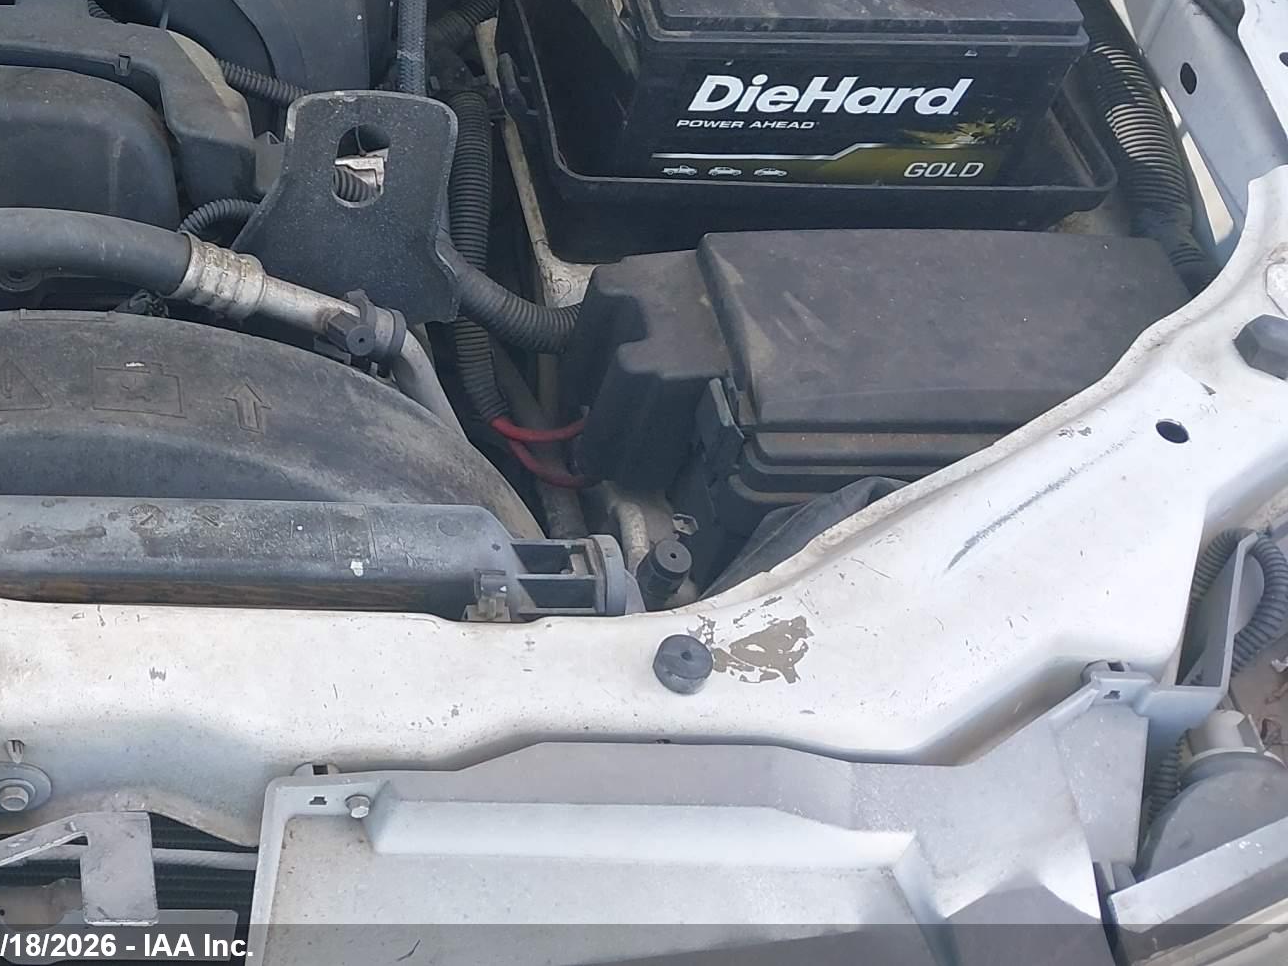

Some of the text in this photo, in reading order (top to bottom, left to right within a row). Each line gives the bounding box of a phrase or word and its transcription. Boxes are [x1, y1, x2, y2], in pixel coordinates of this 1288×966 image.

[687, 74, 974, 115] DieHard
[676, 119, 815, 130] POWER AHEAD
[903, 162, 984, 179] GOLD
